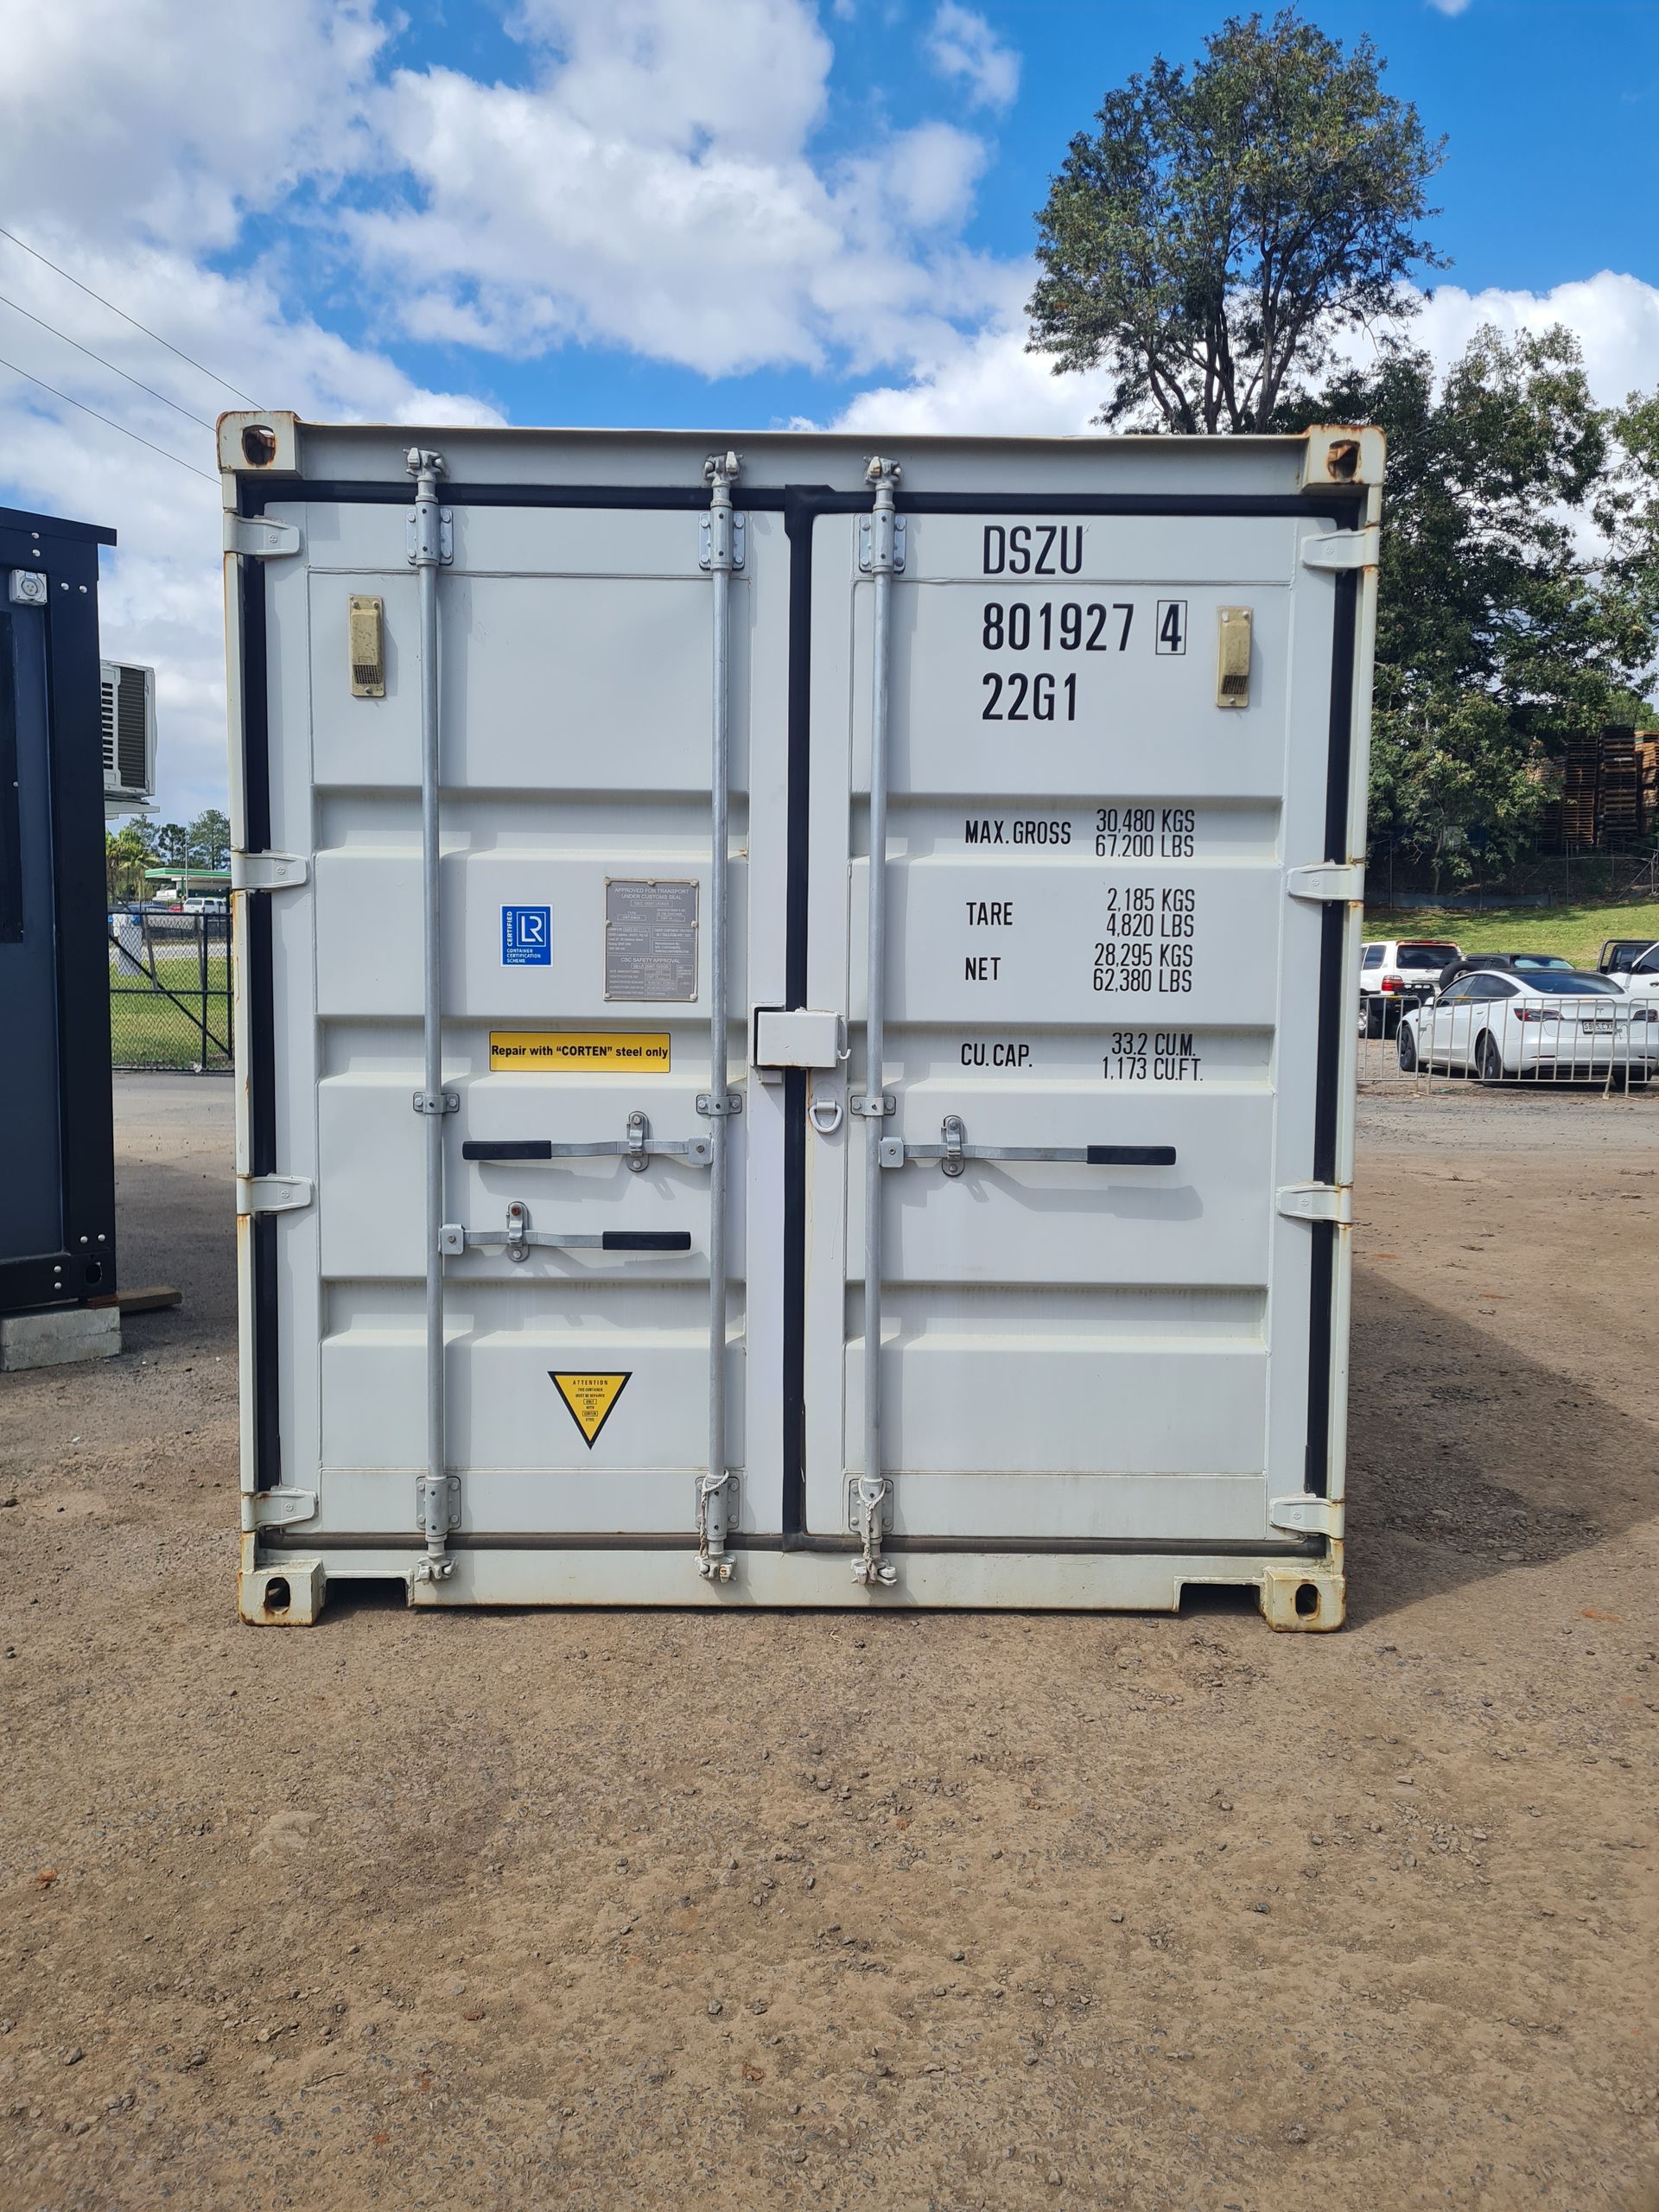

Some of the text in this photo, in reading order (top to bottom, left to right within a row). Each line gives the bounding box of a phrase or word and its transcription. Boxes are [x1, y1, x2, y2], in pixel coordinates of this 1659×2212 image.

[983, 525, 1084, 575] DSZU
[982, 602, 1182, 652] 801927 4
[982, 672, 1077, 721] 22G1
[1096, 809, 1155, 834] 30,480
[1161, 809, 1195, 833] KGS
[1161, 835, 1194, 858] LBS
[966, 887, 1195, 926] TARE 2,185 KGS
[521, 915, 544, 943] LR
[1106, 912, 1194, 938] 4,820 LBS
[965, 943, 1193, 981] NET 28,295 KGS
[1093, 968, 1192, 993] 62,380 LBS
[491, 1045, 526, 1058] Repair
[530, 1046, 553, 1056] with
[615, 1046, 642, 1057] steel
[645, 1046, 669, 1059] only
[1111, 1032, 1148, 1056] 33.2
[1103, 1056, 1147, 1080] 1,173
